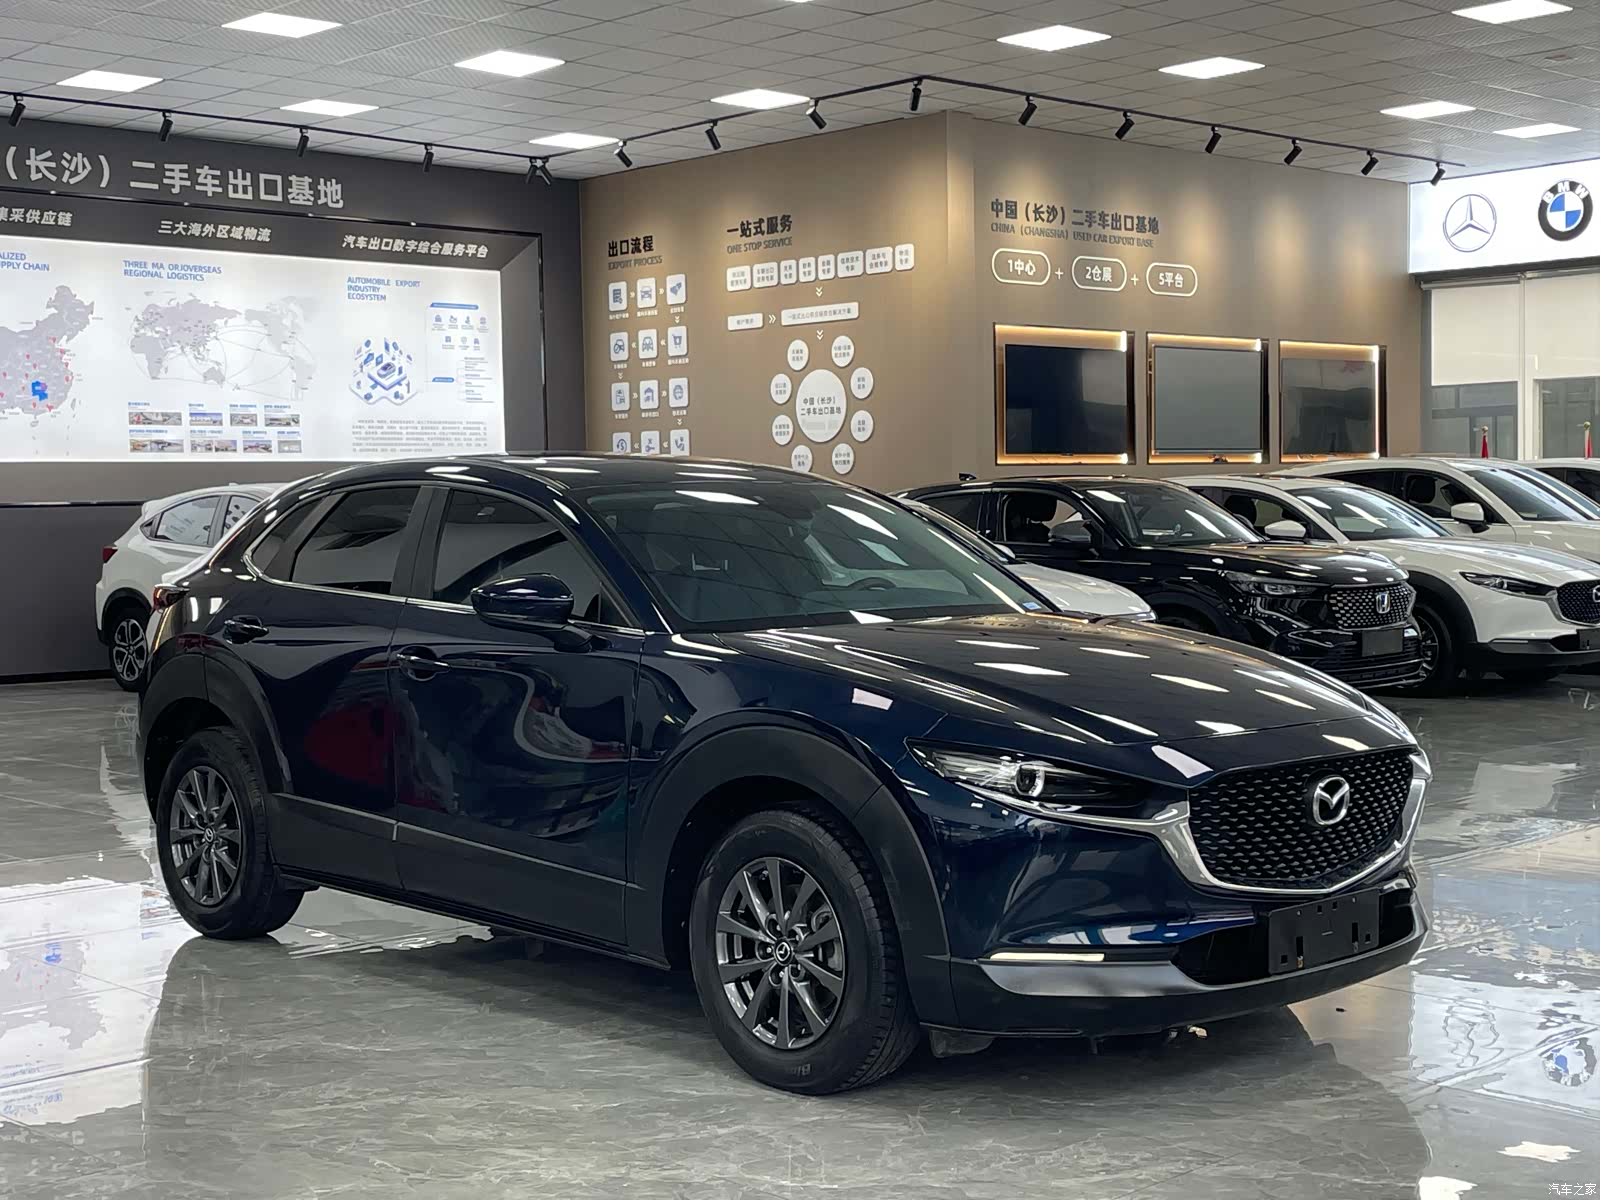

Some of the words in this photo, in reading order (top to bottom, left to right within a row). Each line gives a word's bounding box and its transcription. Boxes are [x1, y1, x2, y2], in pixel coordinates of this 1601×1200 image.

[158, 220, 272, 242] 三大海外区域物流
[726, 214, 793, 238] 一站式服务
[991, 222, 1016, 235] CHINA
[342, 235, 489, 258] 汽车出口数字综合服务平台
[608, 235, 655, 258] 出口流程
[727, 244, 743, 254] ONE
[743, 240, 762, 253] STOP
[763, 236, 793, 249] SERVICE
[23, 262, 50, 271] CHAIN
[123, 260, 148, 269] THREE
[1008, 259, 1036, 276] 1中心
[124, 269, 163, 279] REGIONAL
[167, 272, 205, 282] LOGISTICS
[347, 276, 390, 286] AUTOMOBILE
[396, 280, 421, 288] EXPORT
[1085, 265, 1113, 283] 2仓展
[1159, 272, 1184, 288] 5平台
[347, 285, 381, 293] INDUSTRY
[347, 292, 387, 301] ECOSYSTEM
